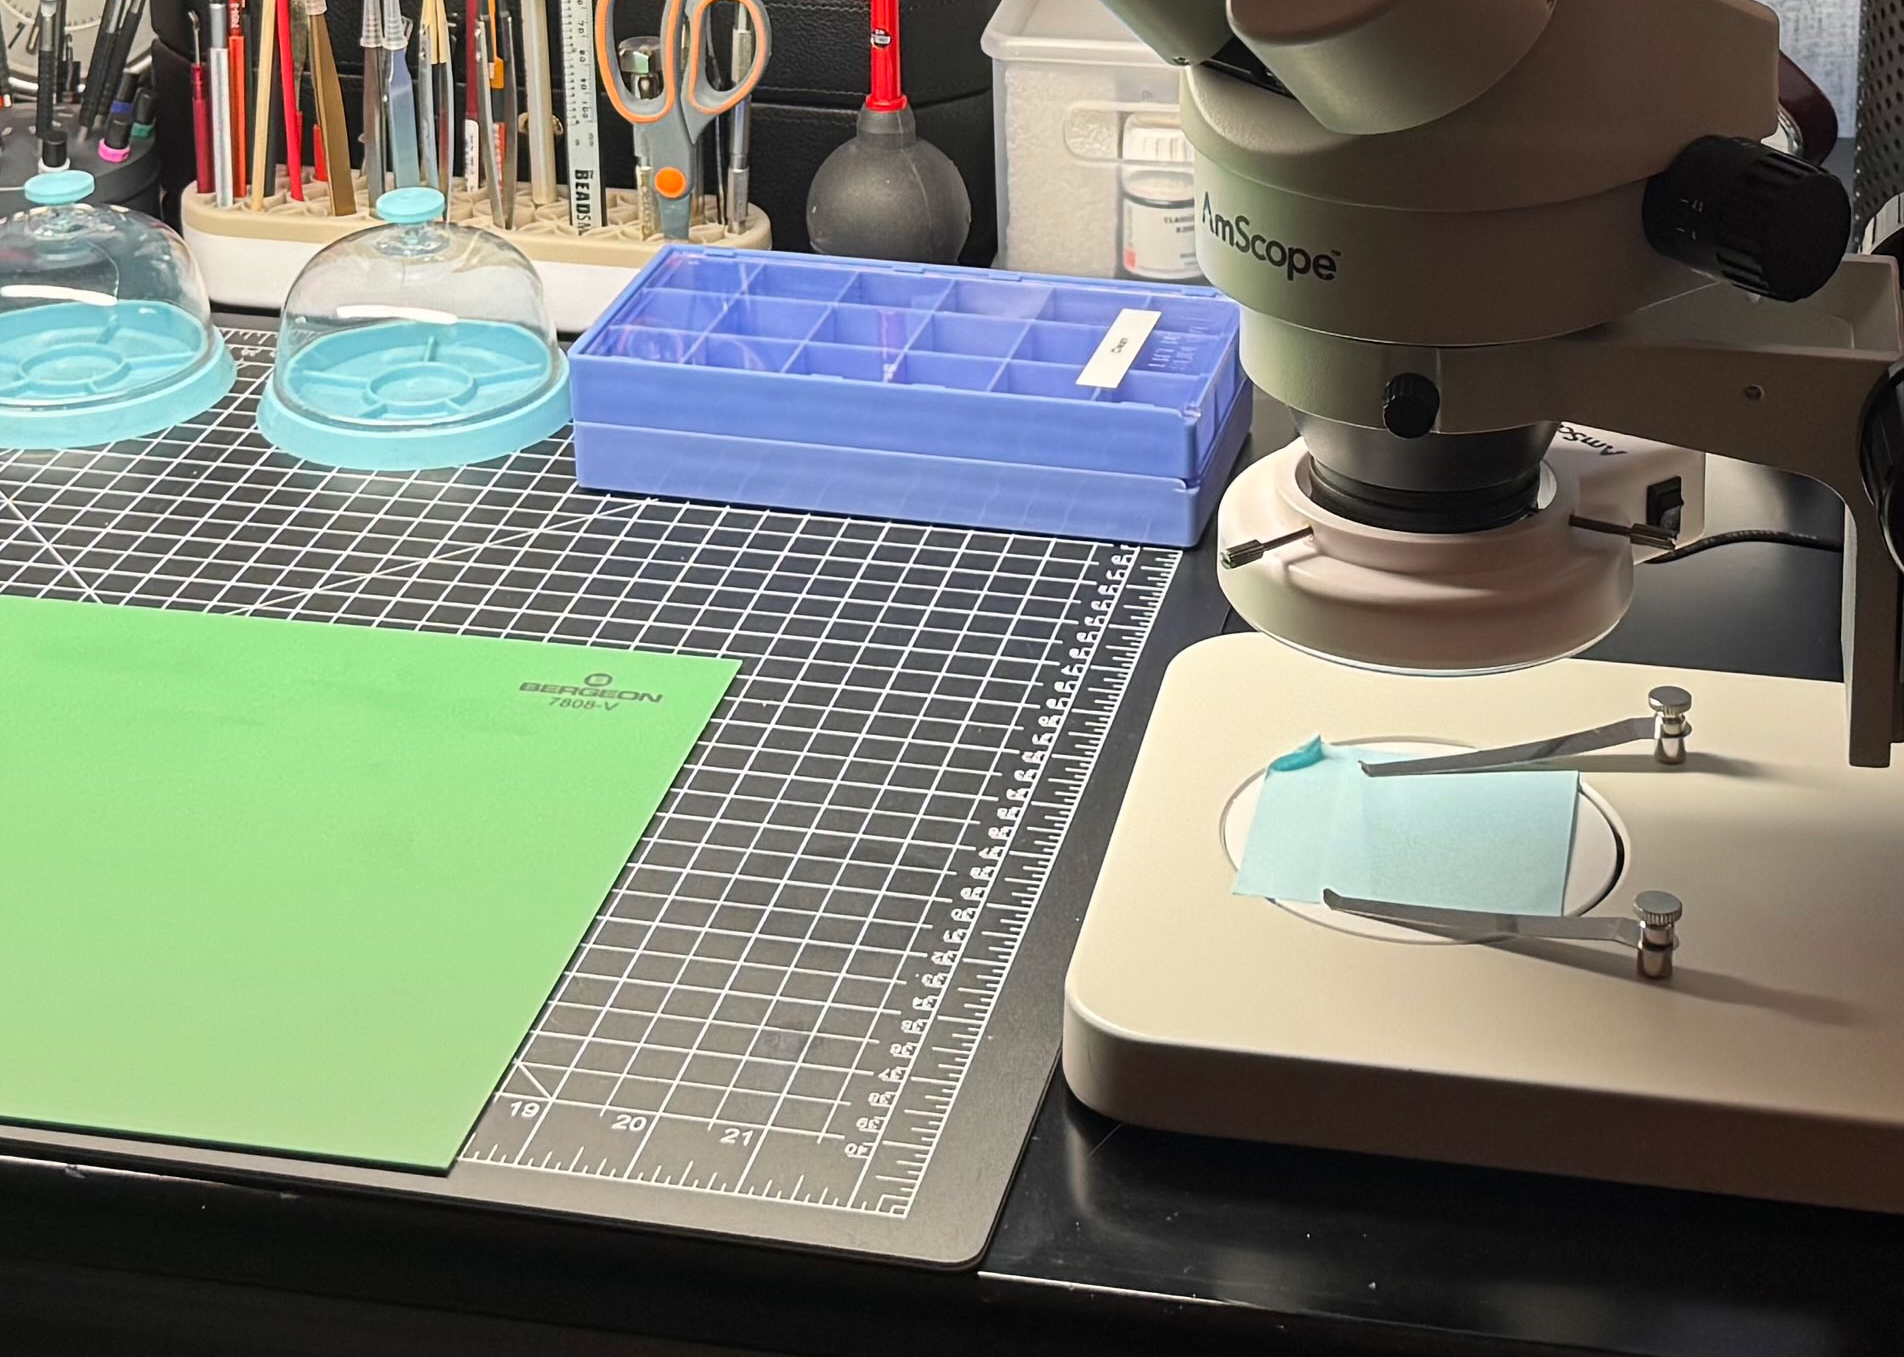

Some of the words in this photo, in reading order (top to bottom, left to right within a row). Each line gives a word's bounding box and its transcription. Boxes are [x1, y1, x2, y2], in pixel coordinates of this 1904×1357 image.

[1202, 191, 1337, 282] AmScope
[519, 682, 663, 703] BERGEON
[549, 697, 619, 711] 7808-V
[510, 1099, 541, 1119] 19
[610, 1113, 648, 1133] 20
[718, 1127, 755, 1147] 21
